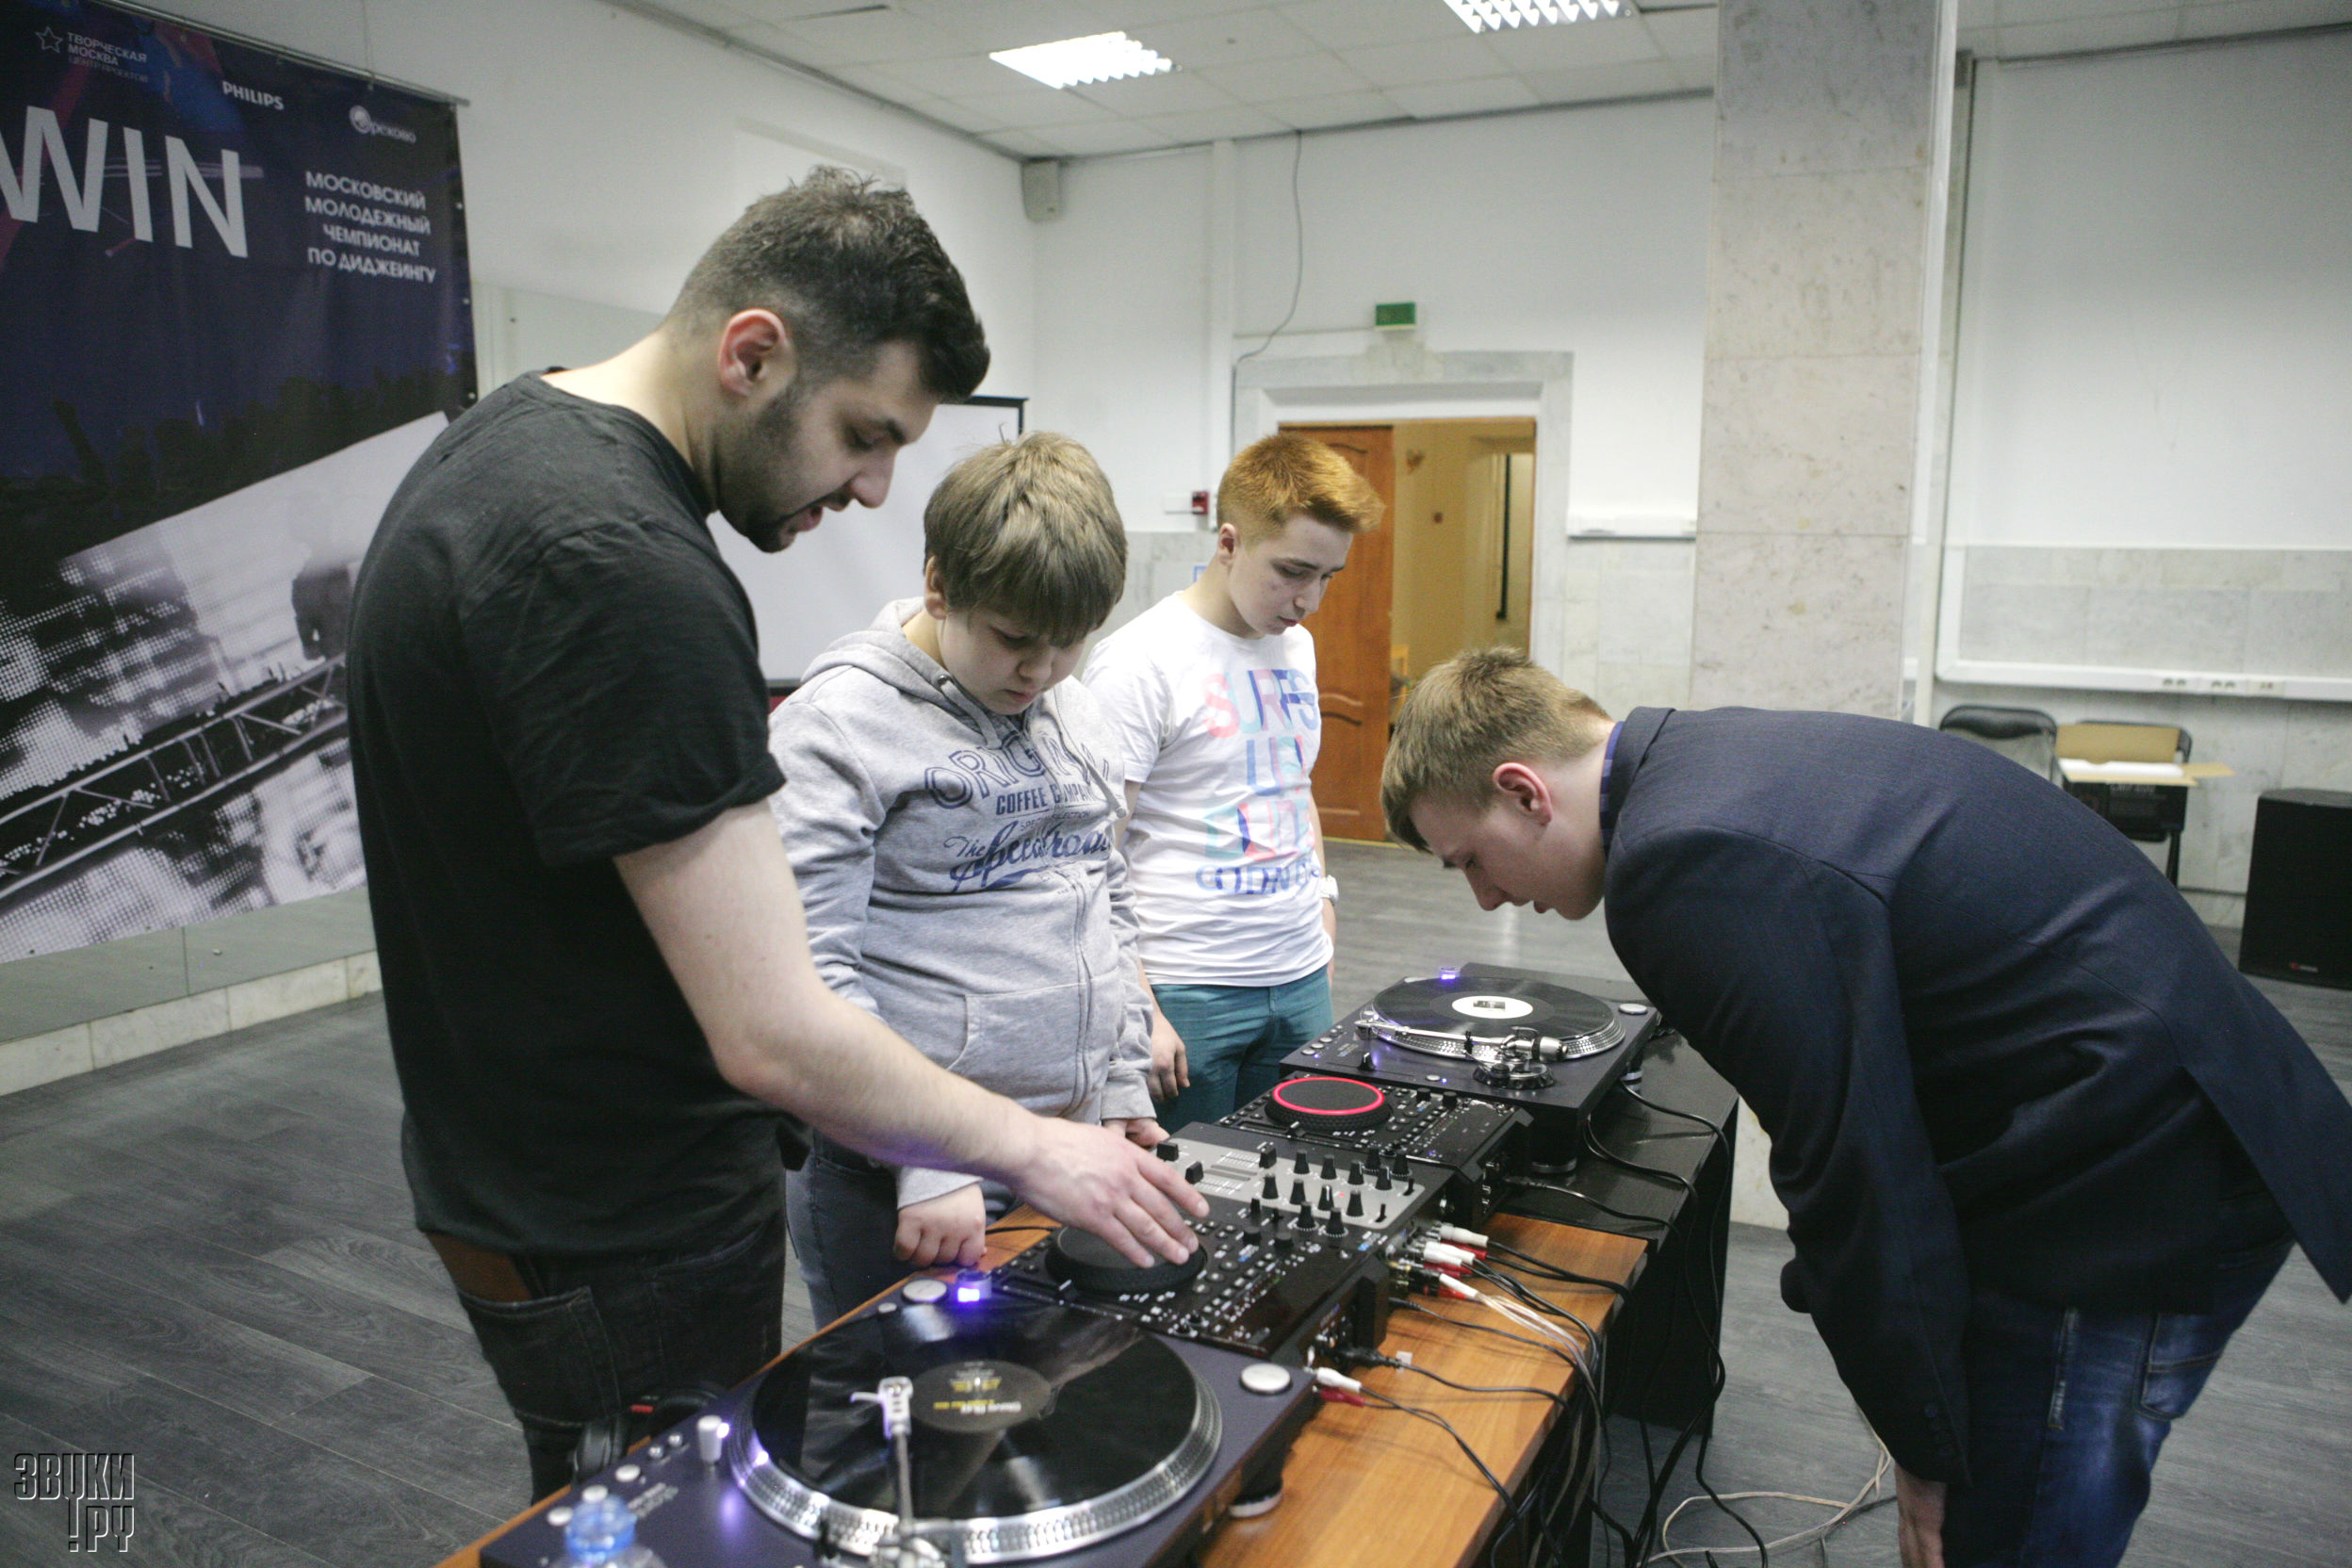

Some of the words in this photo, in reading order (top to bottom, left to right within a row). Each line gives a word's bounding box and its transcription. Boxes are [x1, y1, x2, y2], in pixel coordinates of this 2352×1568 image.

[67, 31, 148, 62] ТВОРЧЕСКАЯ
[67, 42, 119, 66] МОСКВА
[221, 80, 285, 110] PHILIPS
[0, 105, 248, 258] WIN
[305, 171, 426, 211] МОСКОВСКИЙ
[304, 195, 432, 235] МОЛОДЕЖНЫЙ
[322, 223, 421, 257] ЧЕМПИОНАТ
[307, 247, 336, 267] ПО
[995, 786, 1049, 816] COFFEE
[943, 835, 985, 858] The
